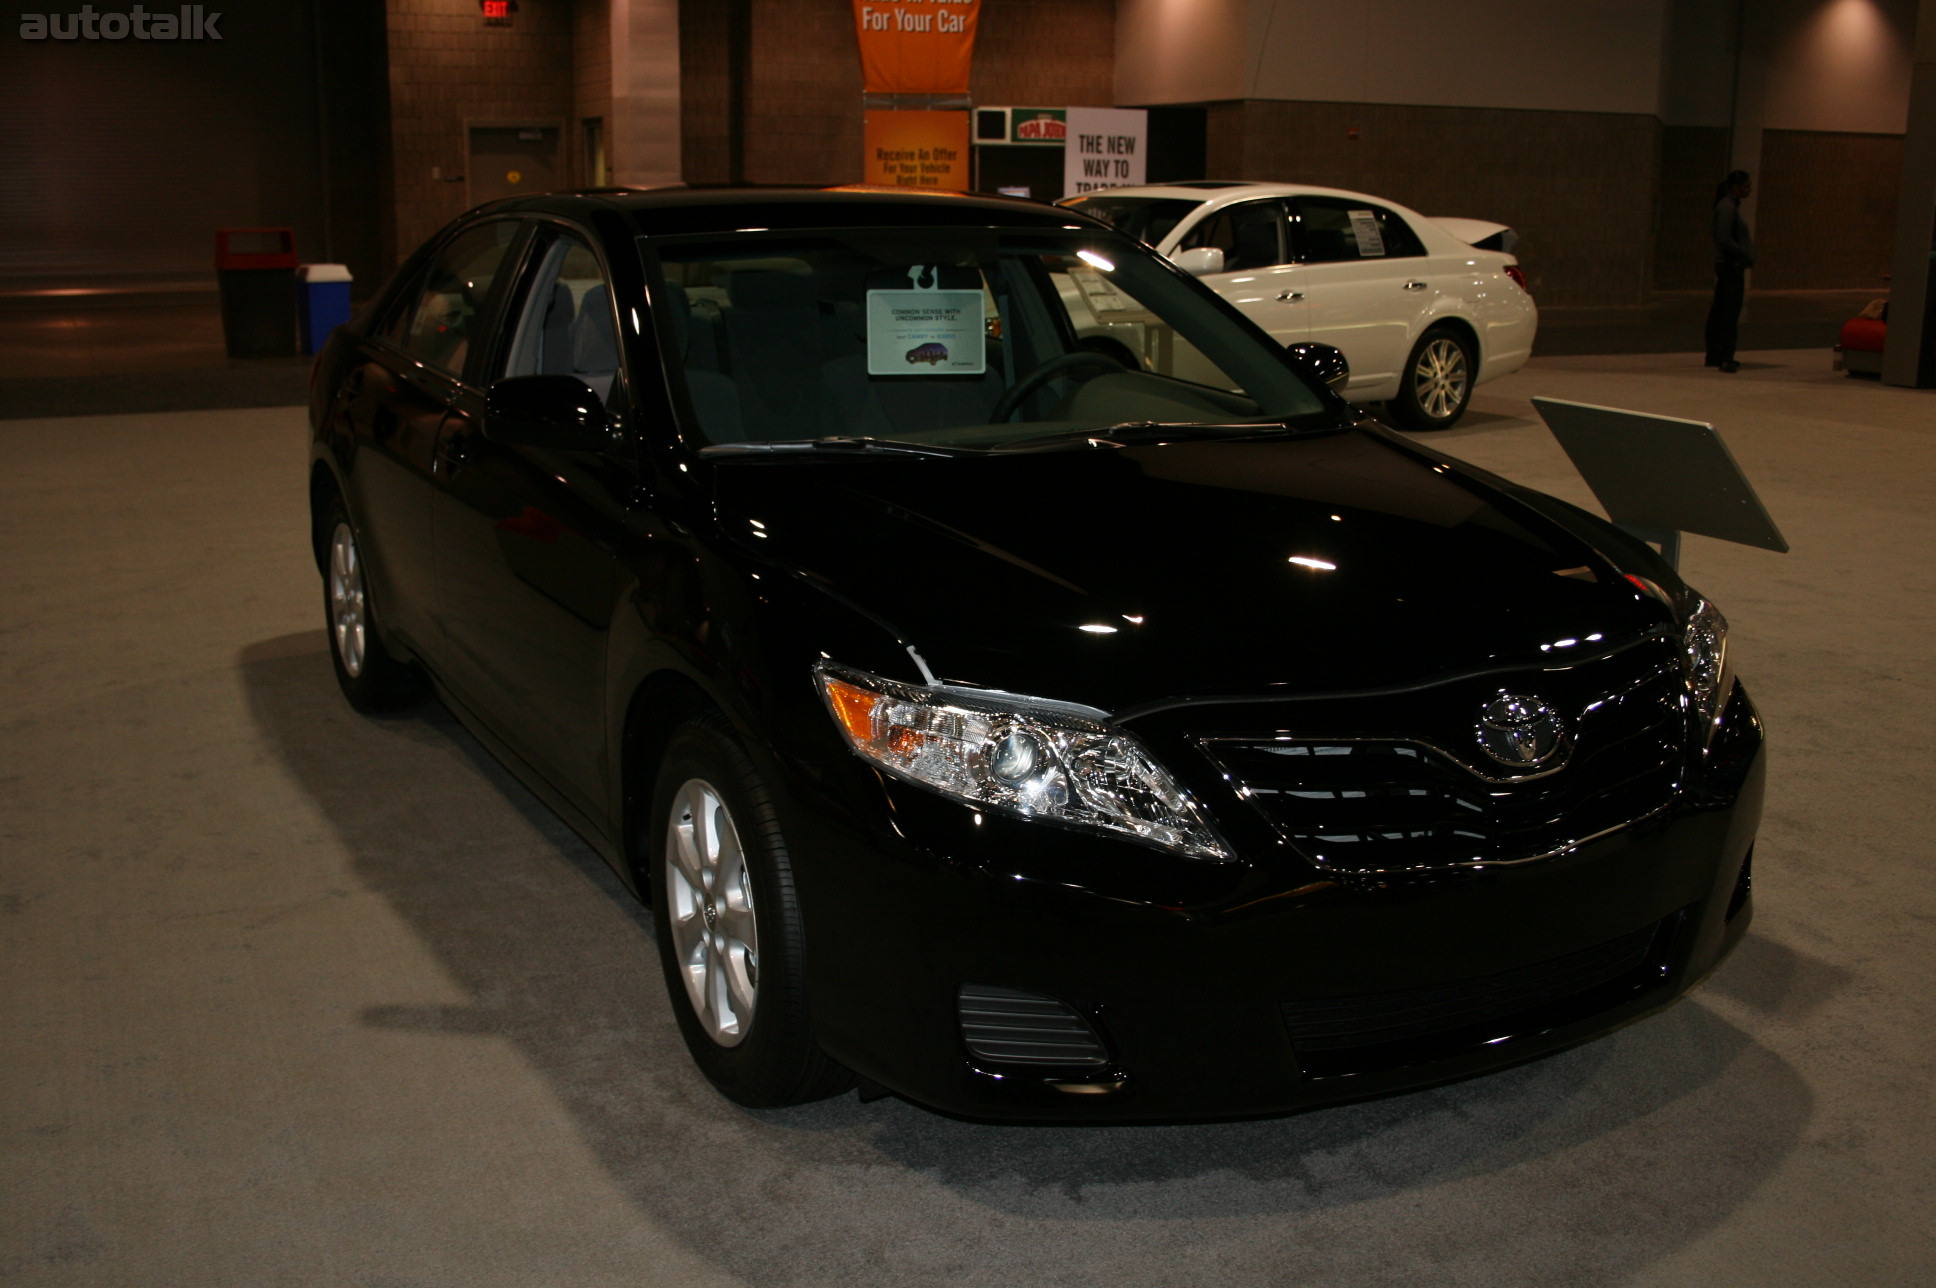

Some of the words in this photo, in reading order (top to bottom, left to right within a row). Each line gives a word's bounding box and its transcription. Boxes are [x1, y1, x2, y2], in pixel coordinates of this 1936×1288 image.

[484, 0, 508, 17] EXIT
[862, 7, 890, 31] For
[894, 8, 933, 32] Your
[937, 9, 966, 33] Car
[1019, 122, 1042, 138] PAPA
[1079, 134, 1103, 154] THE
[1107, 135, 1136, 155] NEW
[877, 147, 915, 161] Receive
[918, 147, 930, 160] An
[933, 147, 957, 161] Offer
[883, 162, 897, 174] For
[900, 162, 917, 174] Your
[920, 162, 951, 174] Vehicle
[1083, 159, 1111, 178] WAY
[1114, 160, 1129, 179] TO
[896, 175, 918, 186] Right
[920, 175, 938, 185] Here
